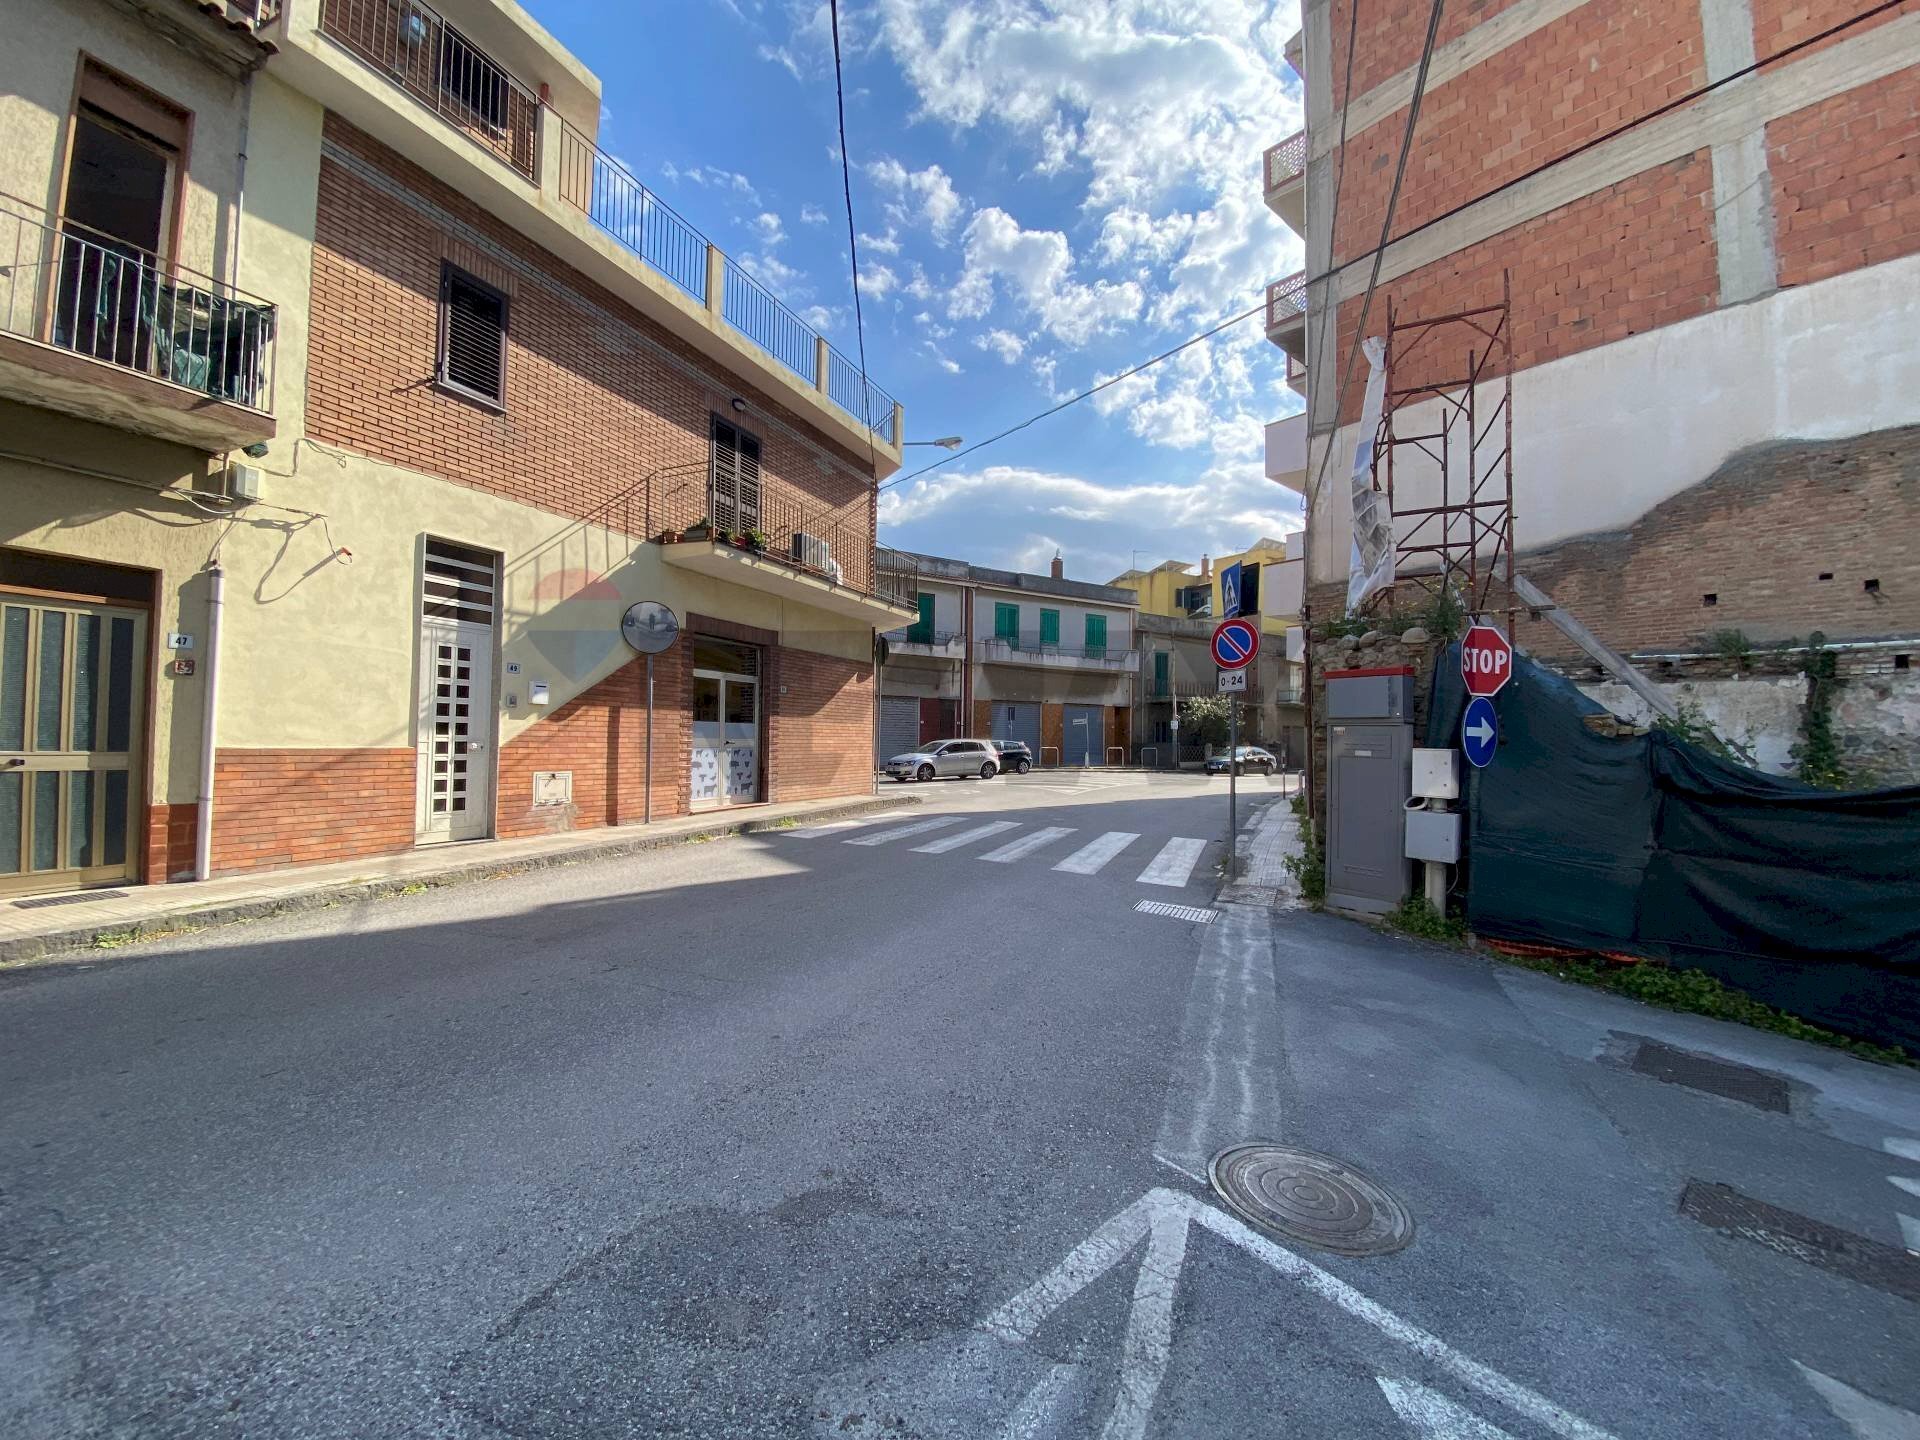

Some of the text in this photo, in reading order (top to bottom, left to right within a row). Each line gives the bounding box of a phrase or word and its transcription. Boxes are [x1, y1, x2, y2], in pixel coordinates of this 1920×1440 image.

[175, 636, 188, 646] 47
[1463, 647, 1508, 675] STOP
[510, 664, 518, 672] 49
